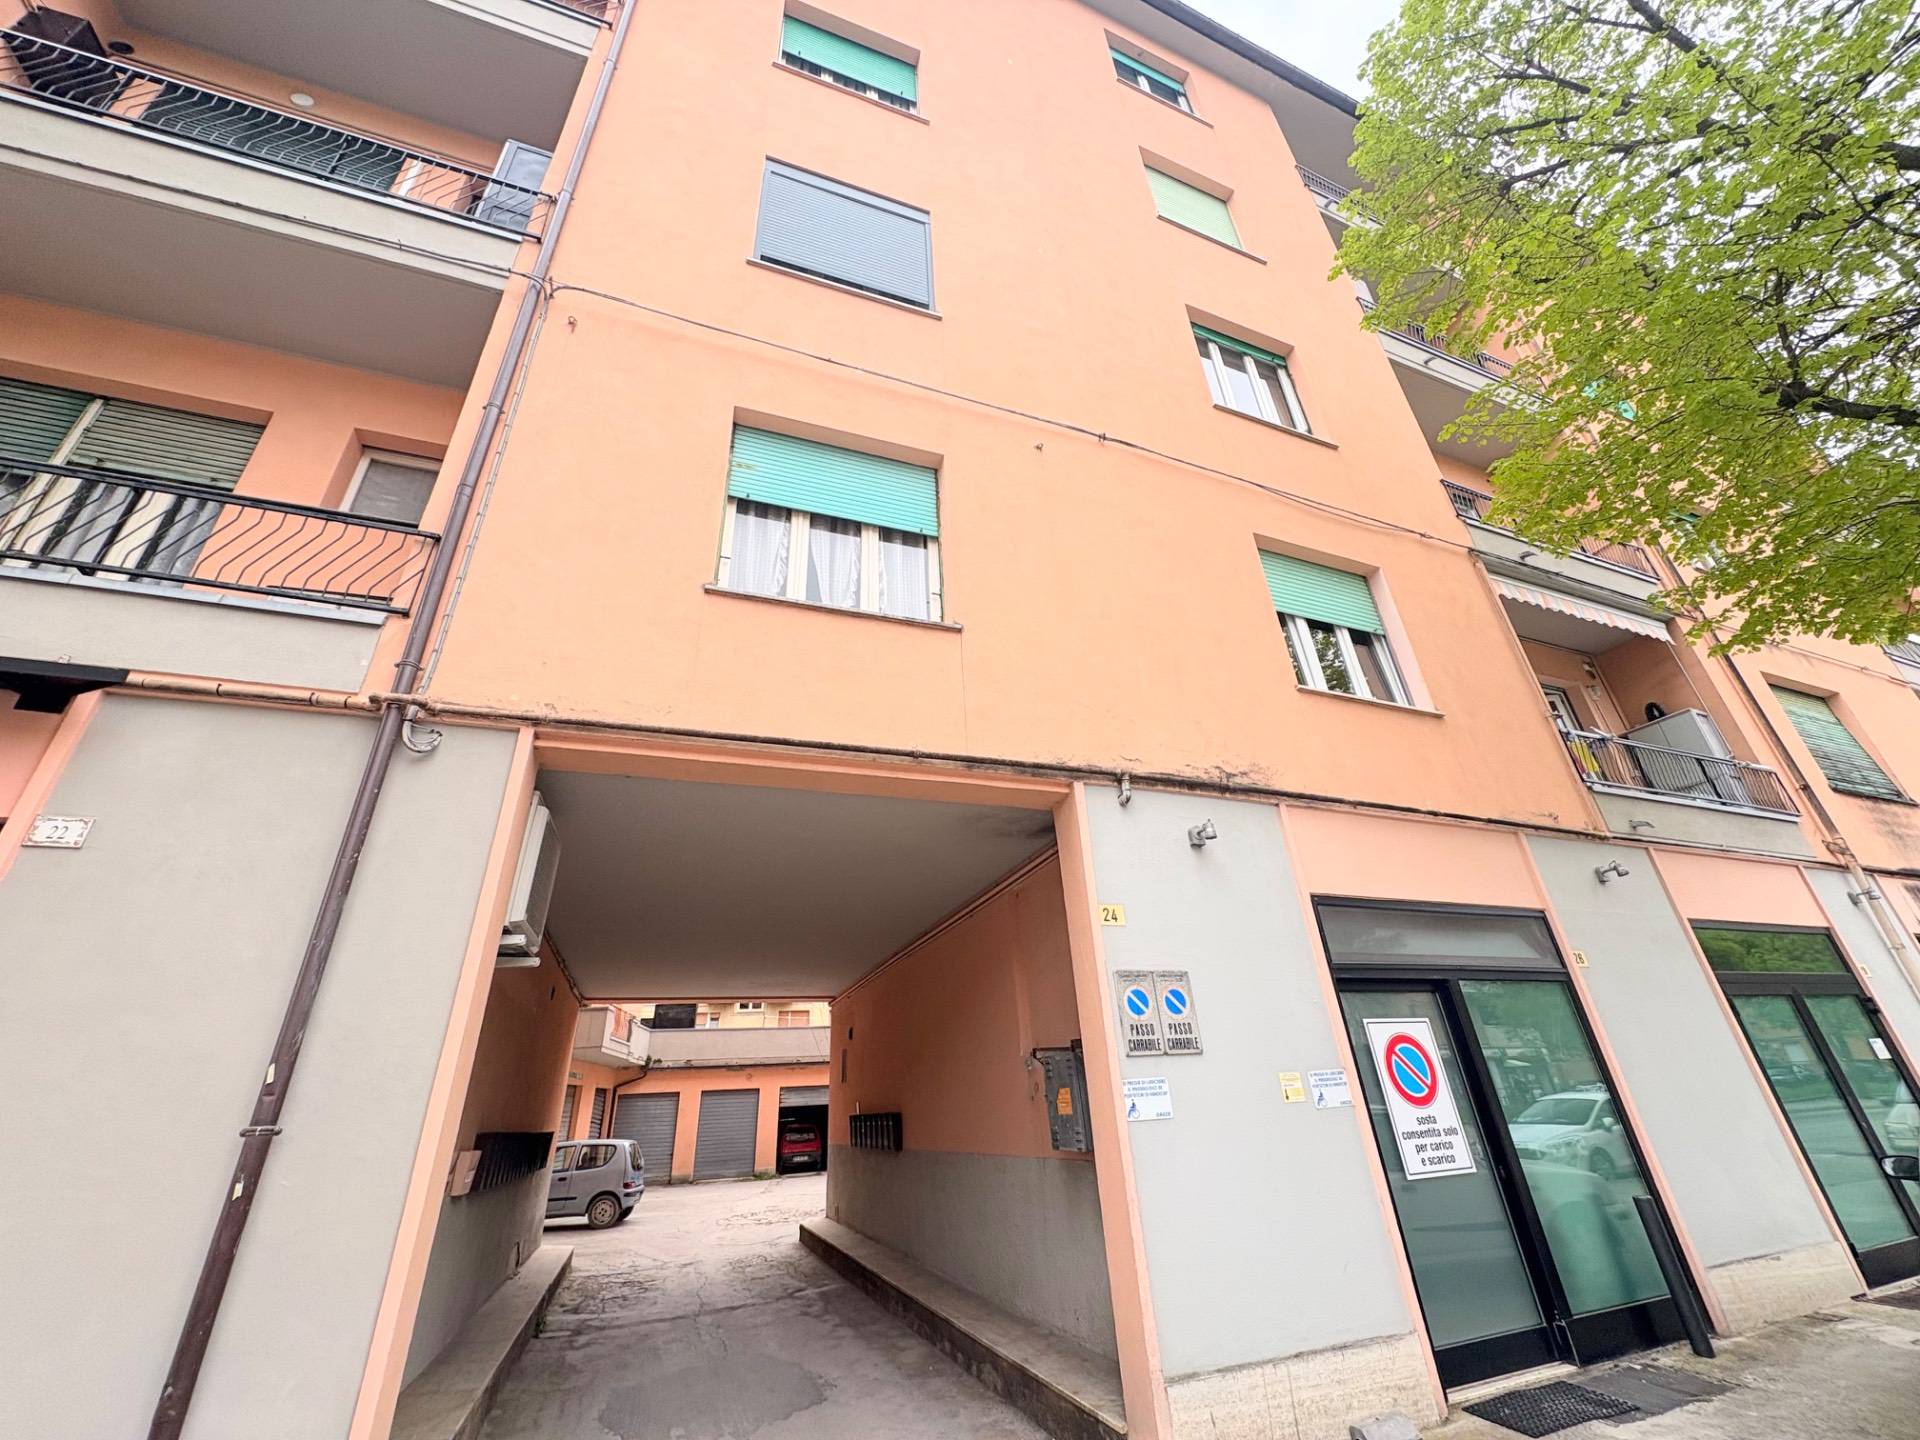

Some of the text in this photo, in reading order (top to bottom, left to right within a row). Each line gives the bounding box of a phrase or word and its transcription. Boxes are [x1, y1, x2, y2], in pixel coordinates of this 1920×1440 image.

[45, 825, 69, 840] 22
[1102, 907, 1118, 923] 24
[1129, 1023, 1155, 1036] PASSO
[1167, 1022, 1193, 1036] PASSO
[1128, 1037, 1162, 1052] CARRABILE
[1166, 1036, 1199, 1050] CARRABILE
[1416, 1114, 1438, 1126] sosta
[1401, 1125, 1459, 1141] consentita solo
[1415, 1139, 1454, 1156] per carico
[1421, 1152, 1456, 1166] e scarico
